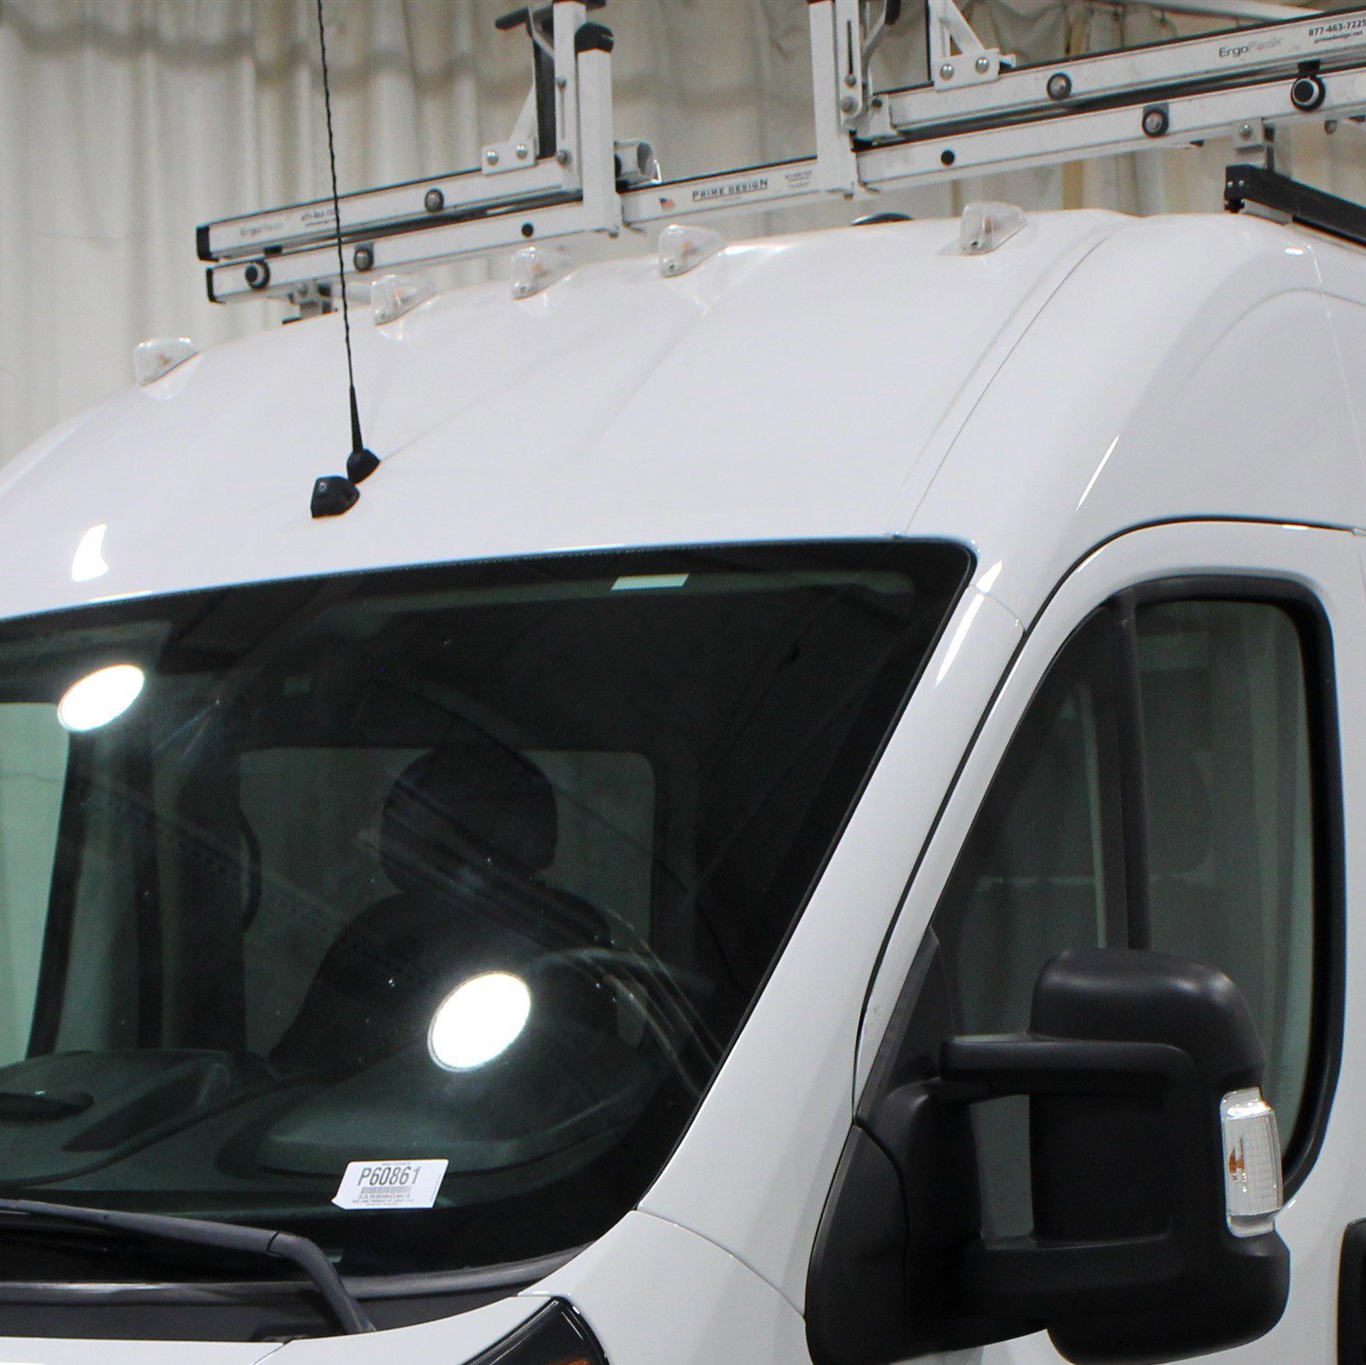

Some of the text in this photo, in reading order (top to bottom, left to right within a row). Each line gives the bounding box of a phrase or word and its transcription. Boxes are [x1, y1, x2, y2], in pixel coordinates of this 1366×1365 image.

[692, 187, 725, 202] PRIME
[729, 179, 769, 195] DESIGN
[357, 1166, 421, 1186] P60861
